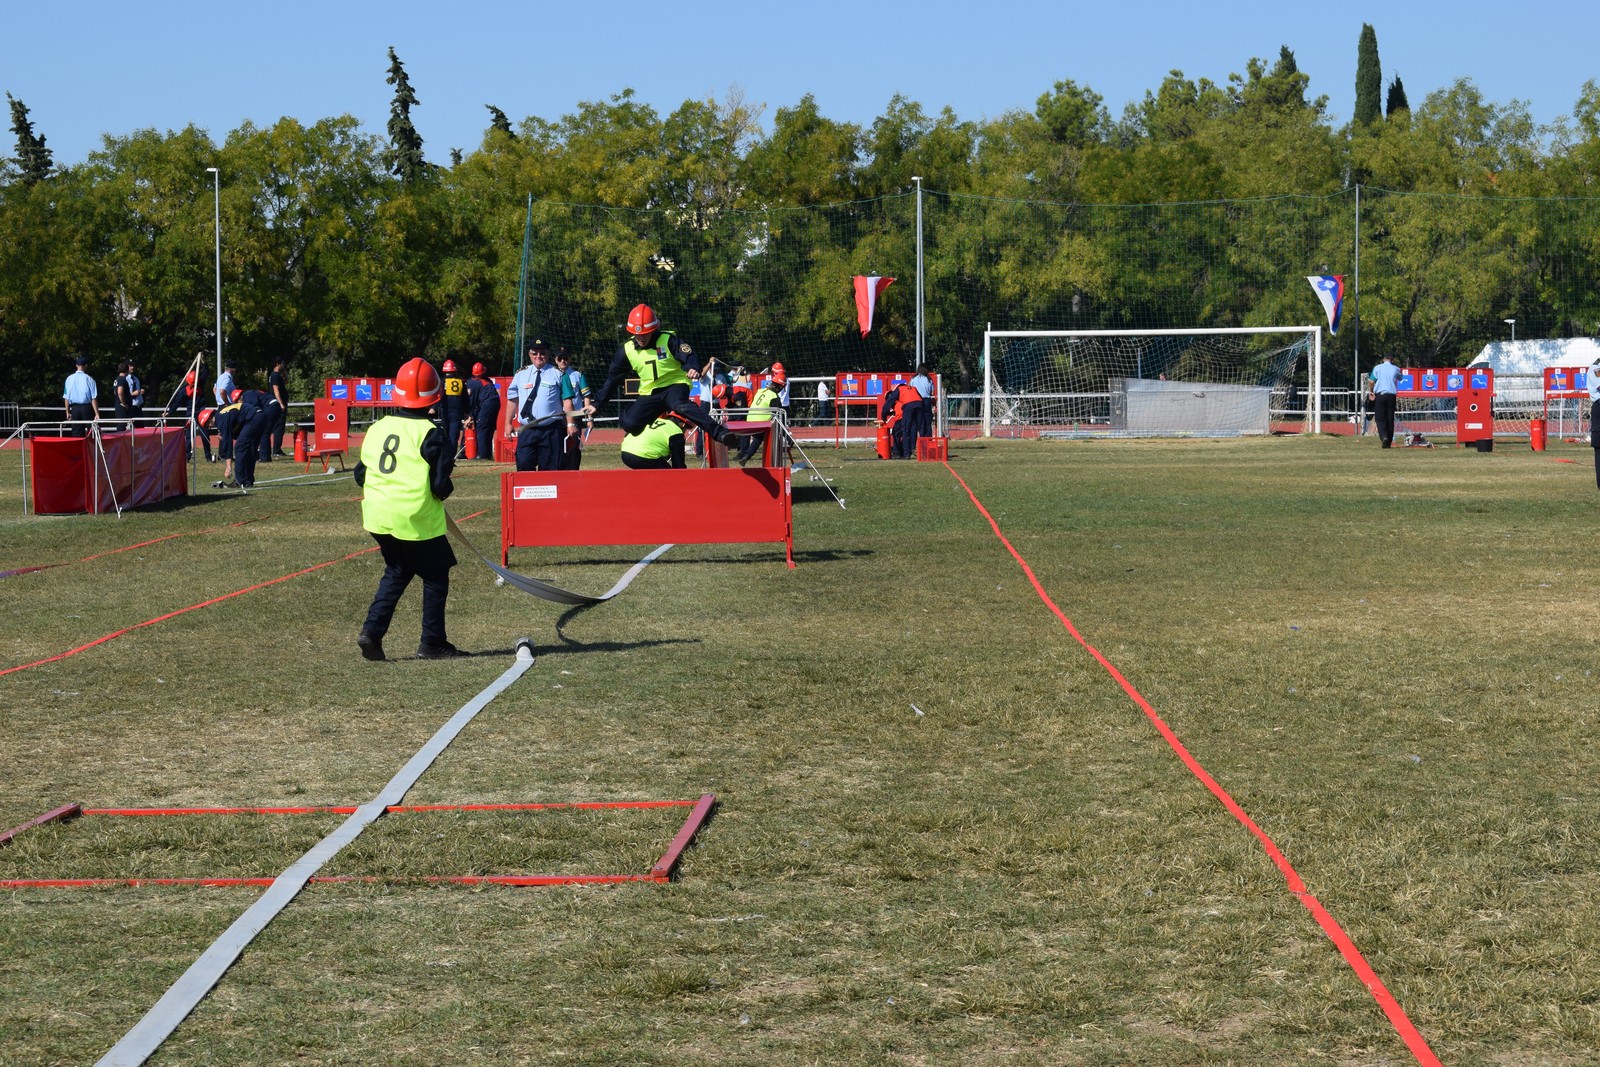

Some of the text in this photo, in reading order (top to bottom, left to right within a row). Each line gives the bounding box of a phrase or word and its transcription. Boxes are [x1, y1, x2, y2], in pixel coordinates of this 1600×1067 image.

[645, 359, 658, 381] 7
[451, 381, 460, 392] 8
[756, 394, 765, 406] 6
[379, 434, 400, 474] 8
